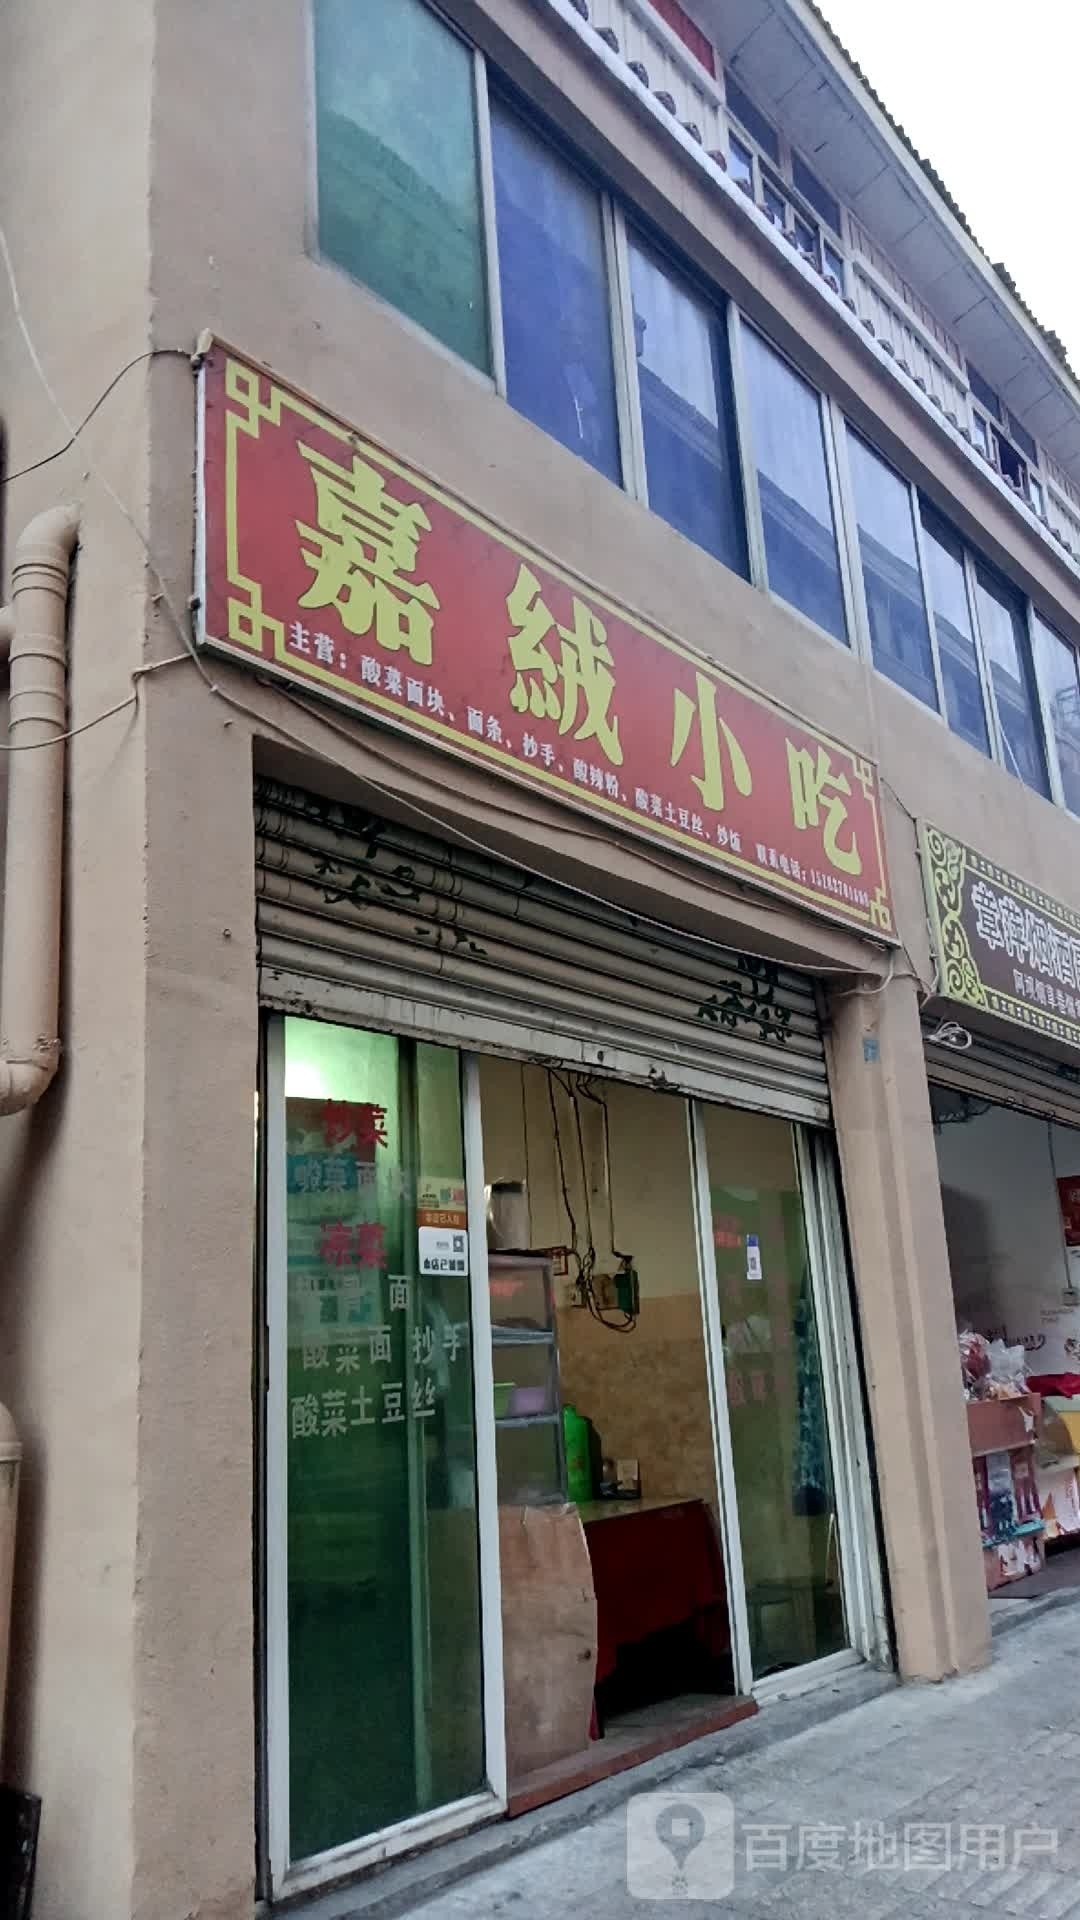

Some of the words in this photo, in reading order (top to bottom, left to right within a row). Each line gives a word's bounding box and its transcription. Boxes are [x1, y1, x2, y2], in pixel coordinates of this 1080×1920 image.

[290, 1377, 437, 1439] 酸菜土豆丝
